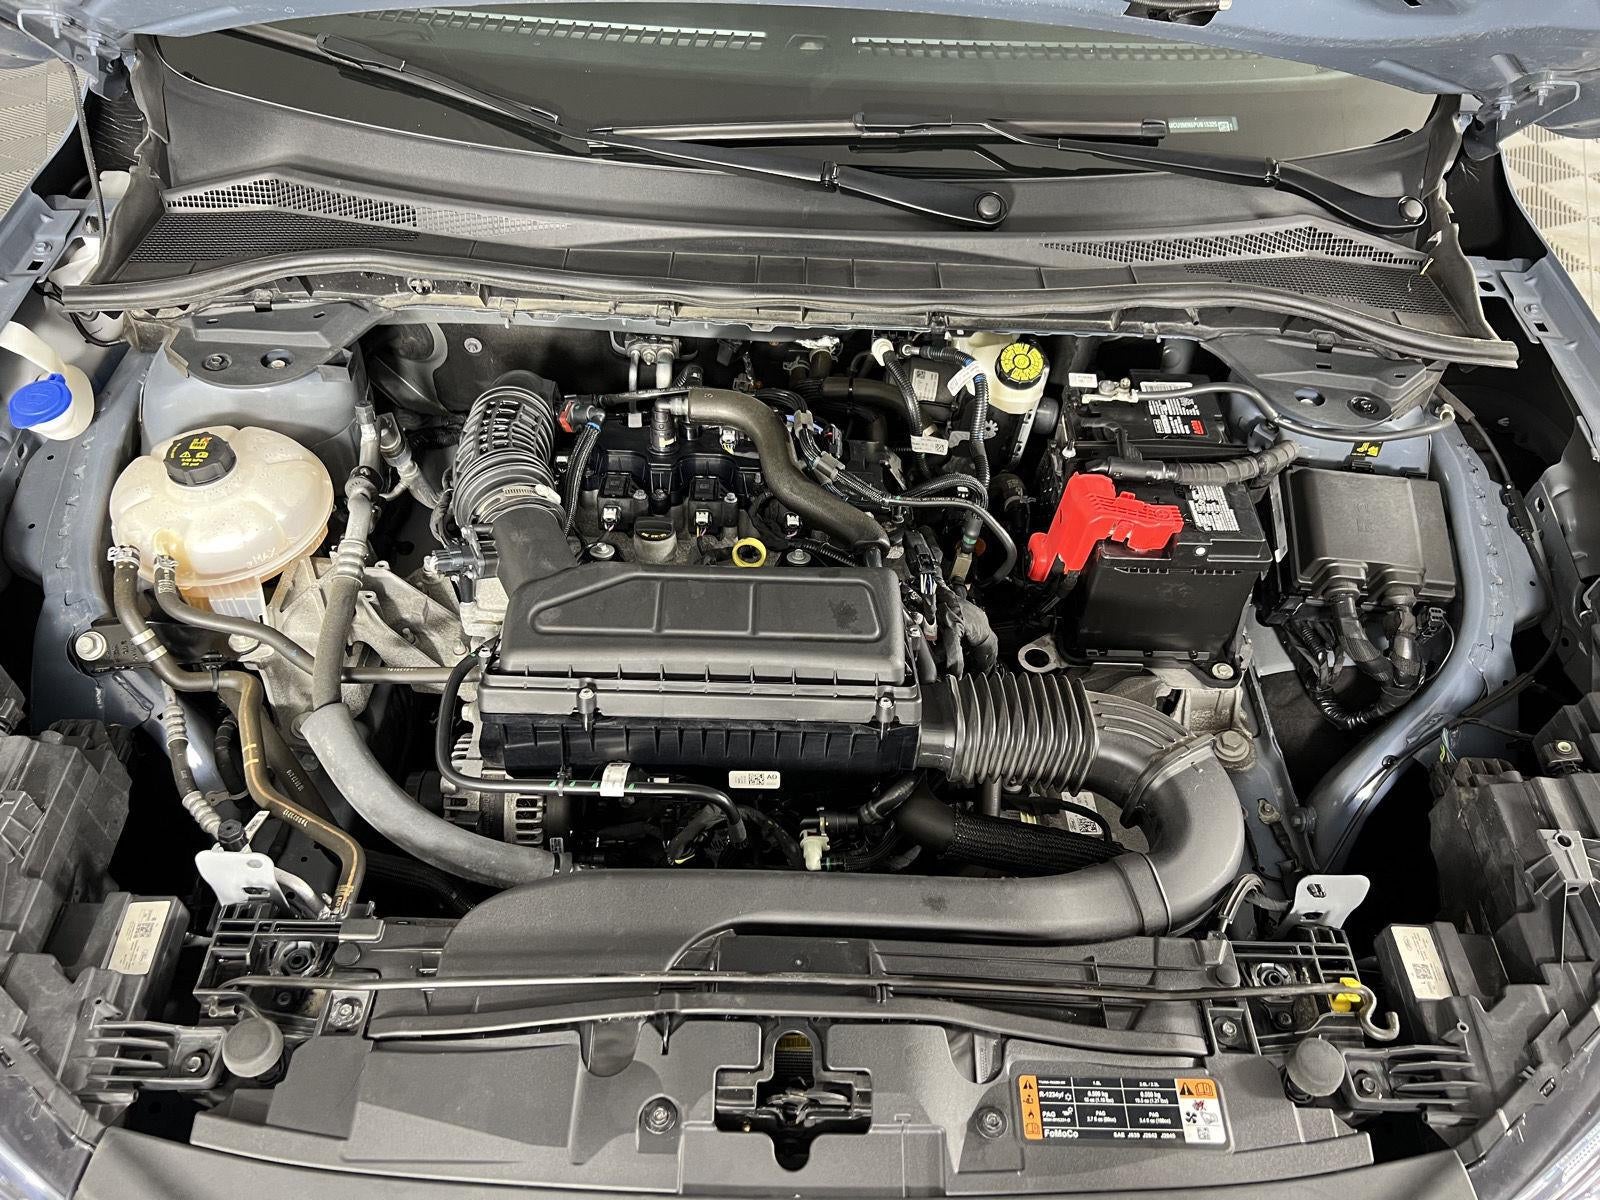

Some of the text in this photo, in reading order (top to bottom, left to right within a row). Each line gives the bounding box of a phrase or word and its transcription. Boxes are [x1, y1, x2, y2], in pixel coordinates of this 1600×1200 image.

[1039, 1090, 1064, 1099] R-1234yf
[1042, 1110, 1056, 1118] PAG
[1044, 1128, 1079, 1138] FoMoCo
